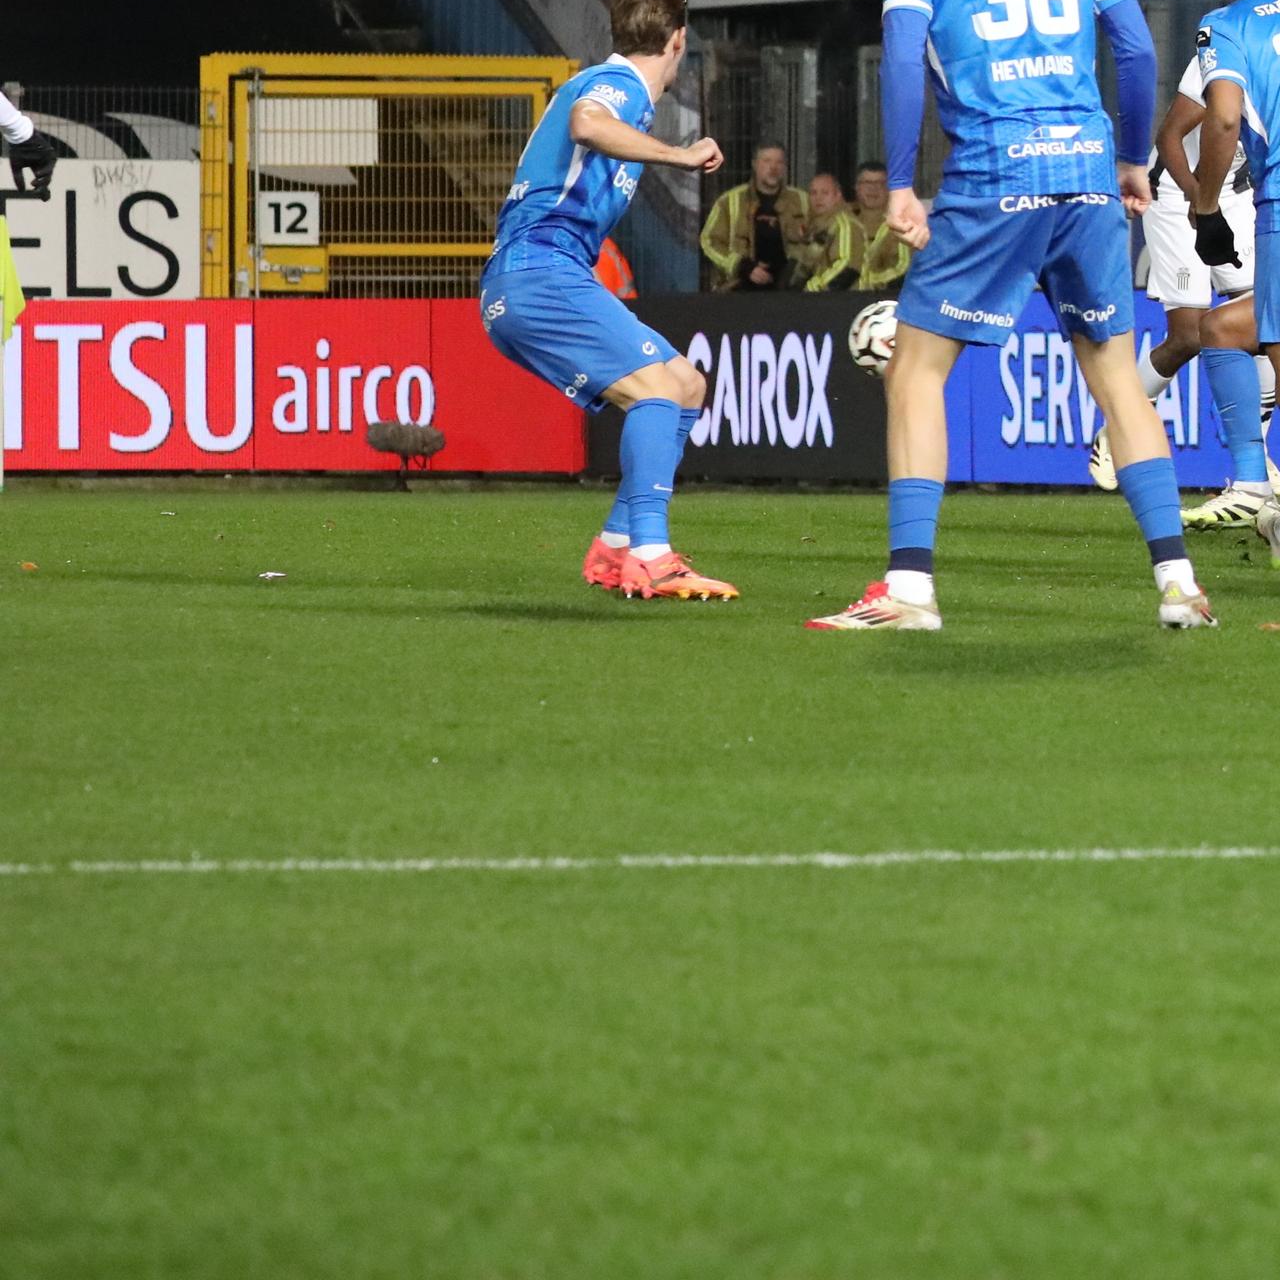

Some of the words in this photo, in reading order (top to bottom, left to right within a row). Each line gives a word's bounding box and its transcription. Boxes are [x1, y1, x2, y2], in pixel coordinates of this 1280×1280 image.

[991, 55, 1074, 82] HEYMANS
[1007, 139, 1104, 159] CARGLASS
[267, 202, 309, 234] 12
[940, 300, 1014, 328] immoweb
[272, 338, 436, 434] airco
[687, 331, 834, 449] CAIROX
